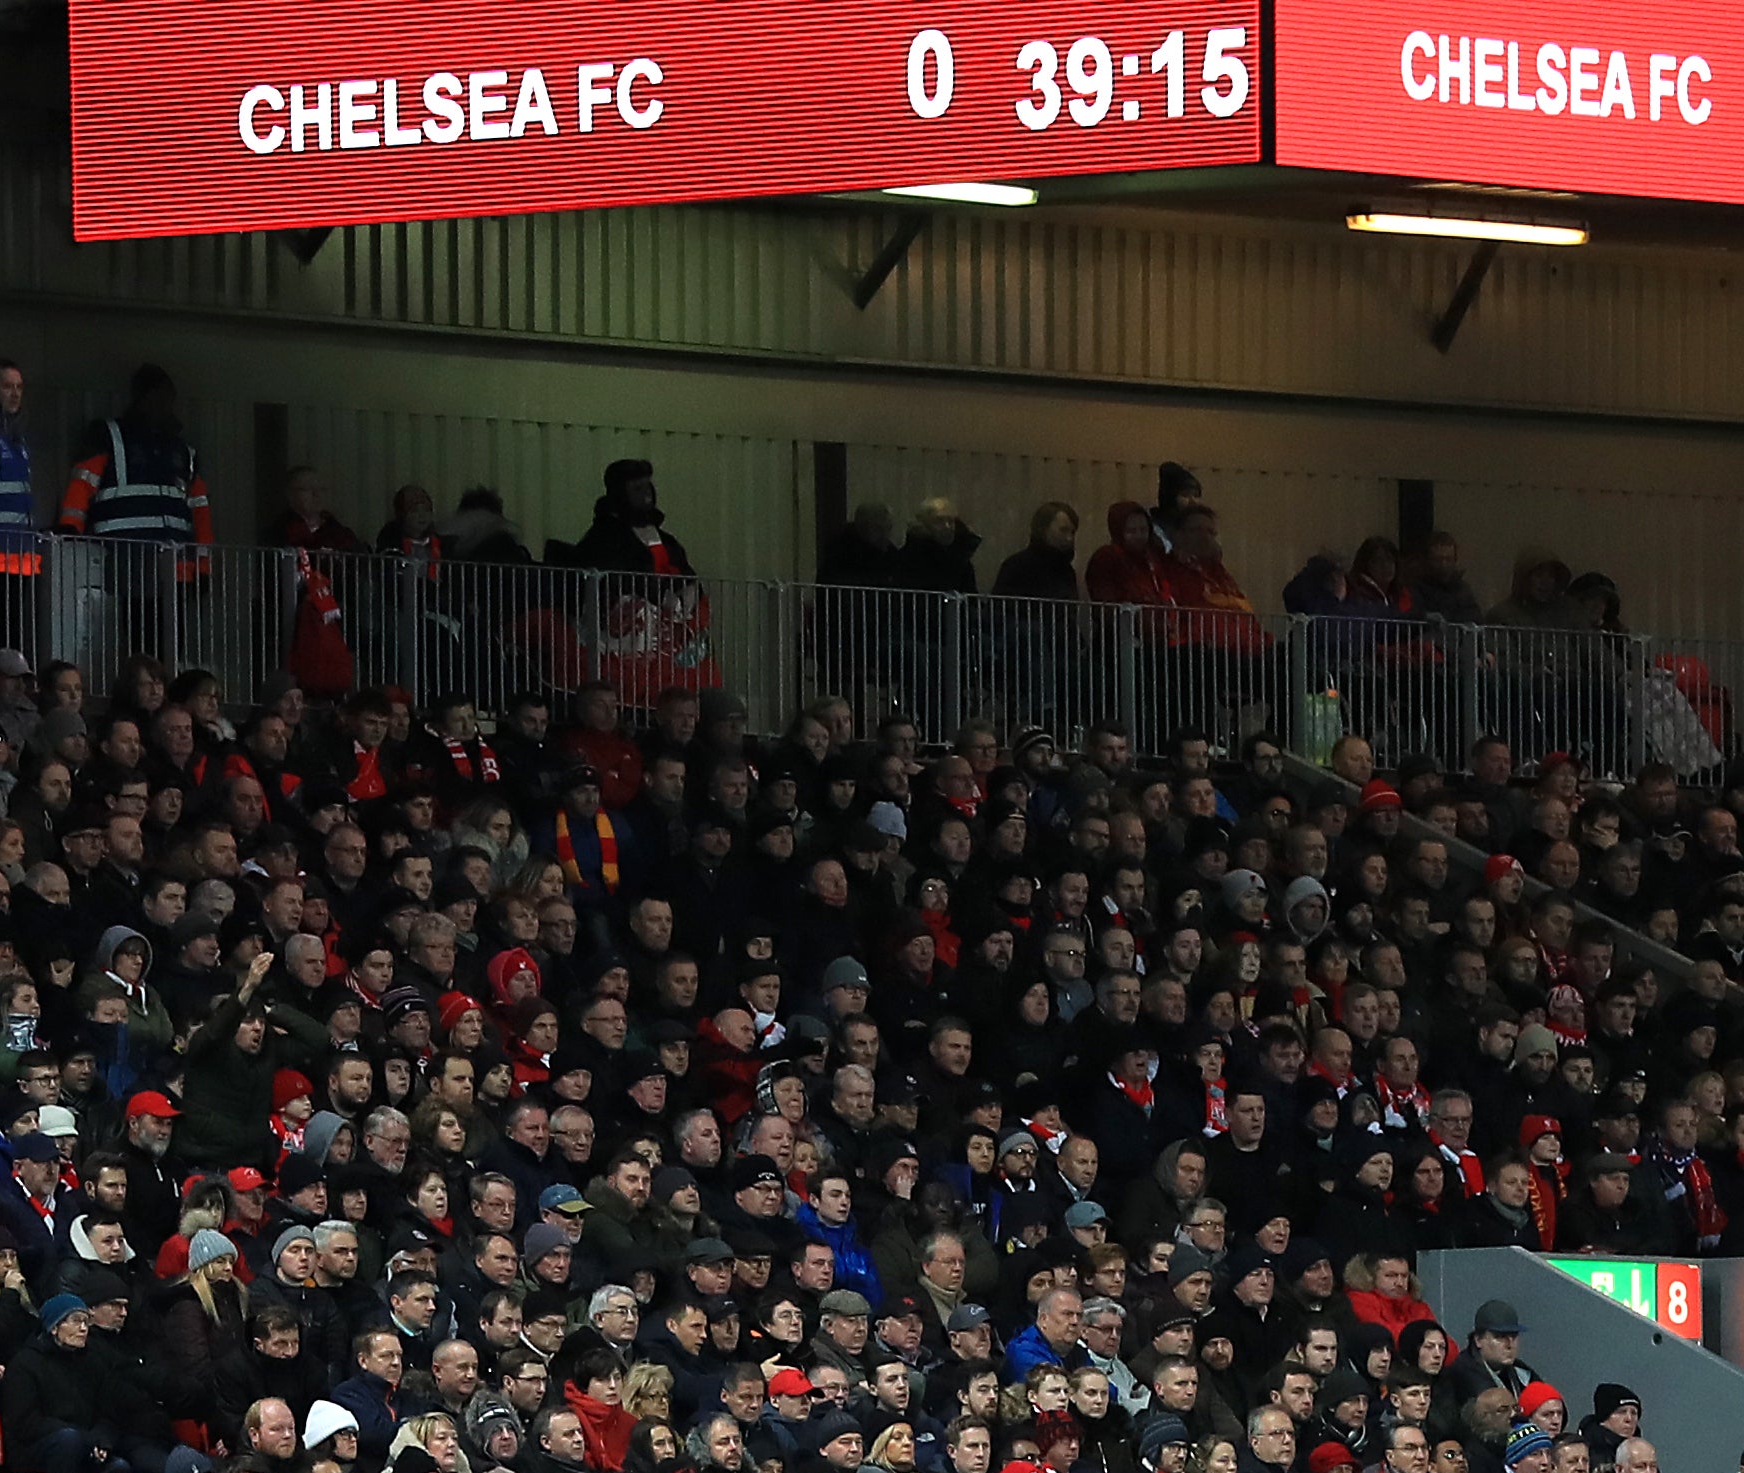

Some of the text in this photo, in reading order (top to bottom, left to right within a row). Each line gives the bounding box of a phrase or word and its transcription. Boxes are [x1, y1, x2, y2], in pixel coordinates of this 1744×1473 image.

[239, 27, 1249, 154] CHELSEA FC 0 39:15
[1401, 30, 1636, 120] CHELSEA
[1649, 53, 1712, 125] FC
[1667, 1281, 1689, 1324] 8
